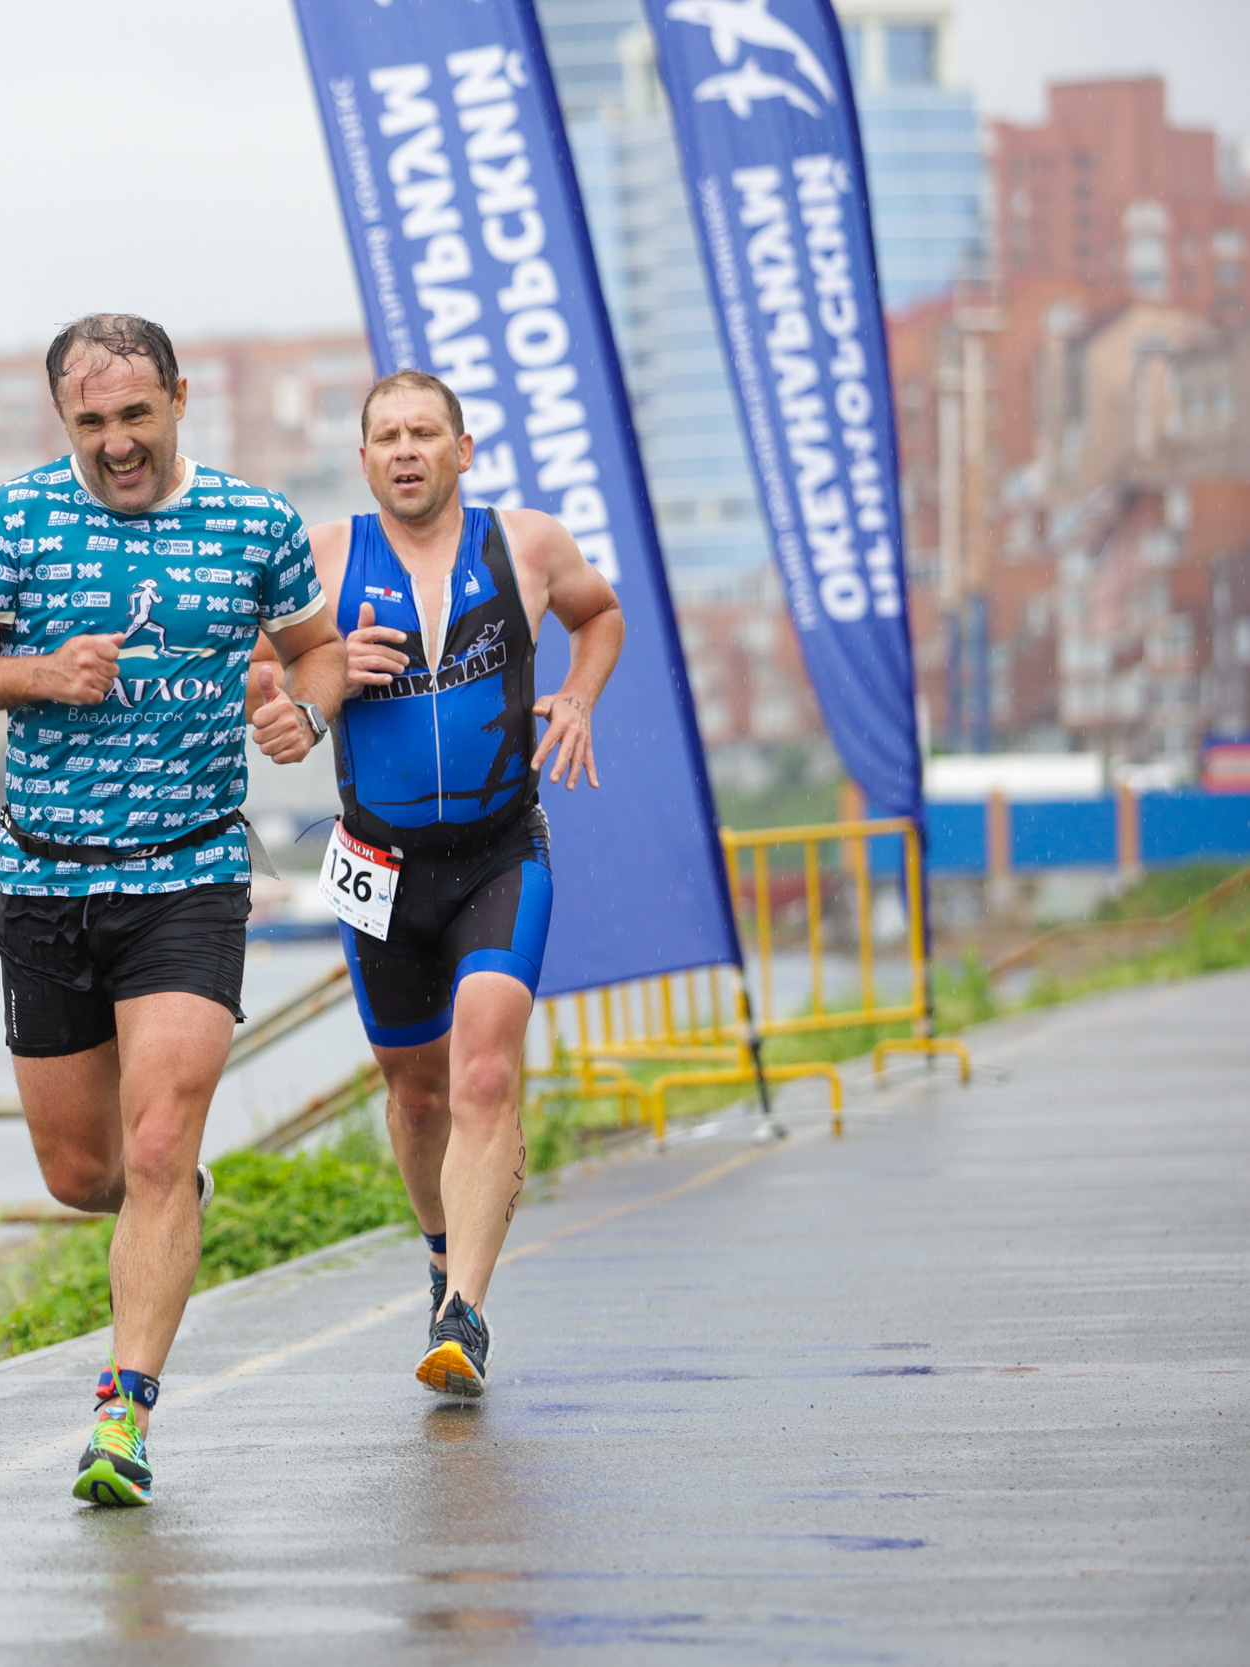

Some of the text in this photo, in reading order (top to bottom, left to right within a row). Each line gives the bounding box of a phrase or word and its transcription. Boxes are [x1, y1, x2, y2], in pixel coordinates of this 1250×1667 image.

[379, 594, 401, 604] CHINA
[67, 707, 184, 725] Владивосток
[330, 848, 373, 903] 126
[505, 1110, 526, 1222] 126
